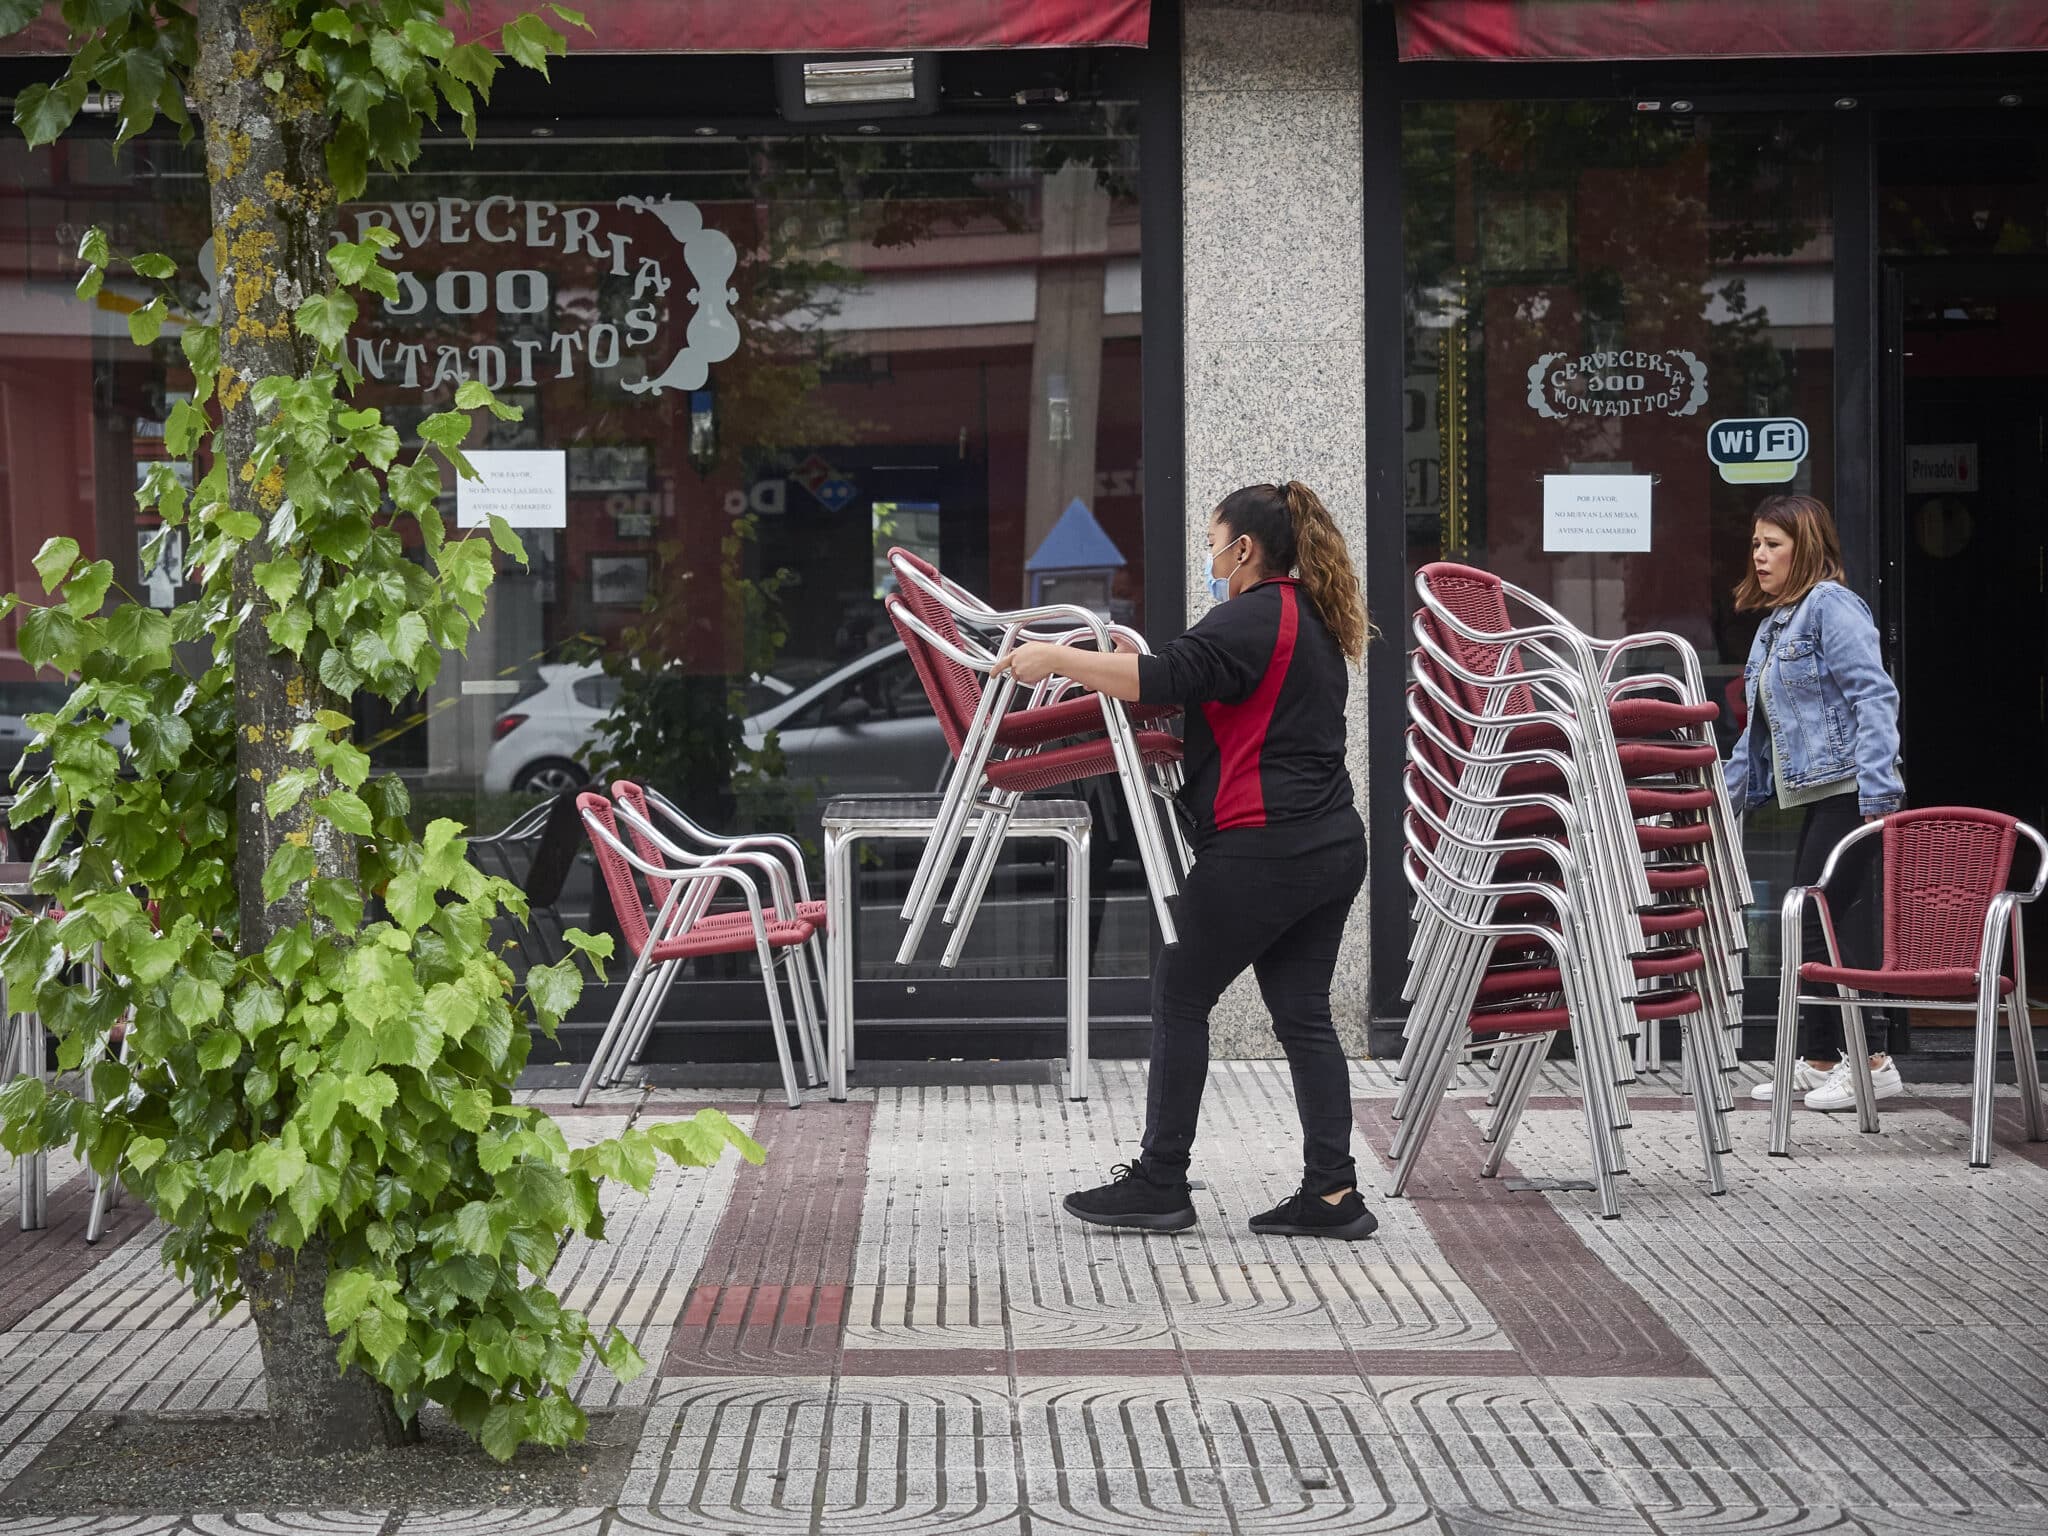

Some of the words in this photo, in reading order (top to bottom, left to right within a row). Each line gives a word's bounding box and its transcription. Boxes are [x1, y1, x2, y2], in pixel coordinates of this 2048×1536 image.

[329, 195, 672, 300] RVECERIA
[332, 303, 658, 393] NTADITOS
[1551, 350, 1686, 388] CERVECERIA
[1588, 375, 1645, 392] 300
[1554, 386, 1681, 417] MONTADITOS
[1911, 456, 1953, 478] Privado
[1576, 495, 1591, 503] POR
[1554, 511, 1566, 519] NO
[1566, 511, 1598, 519] MUEVAN
[1599, 511, 1613, 519] LAS
[1559, 527, 1583, 535] AVISEN
[1584, 527, 1594, 535] AL
[1595, 527, 1637, 535] CAMARERO
